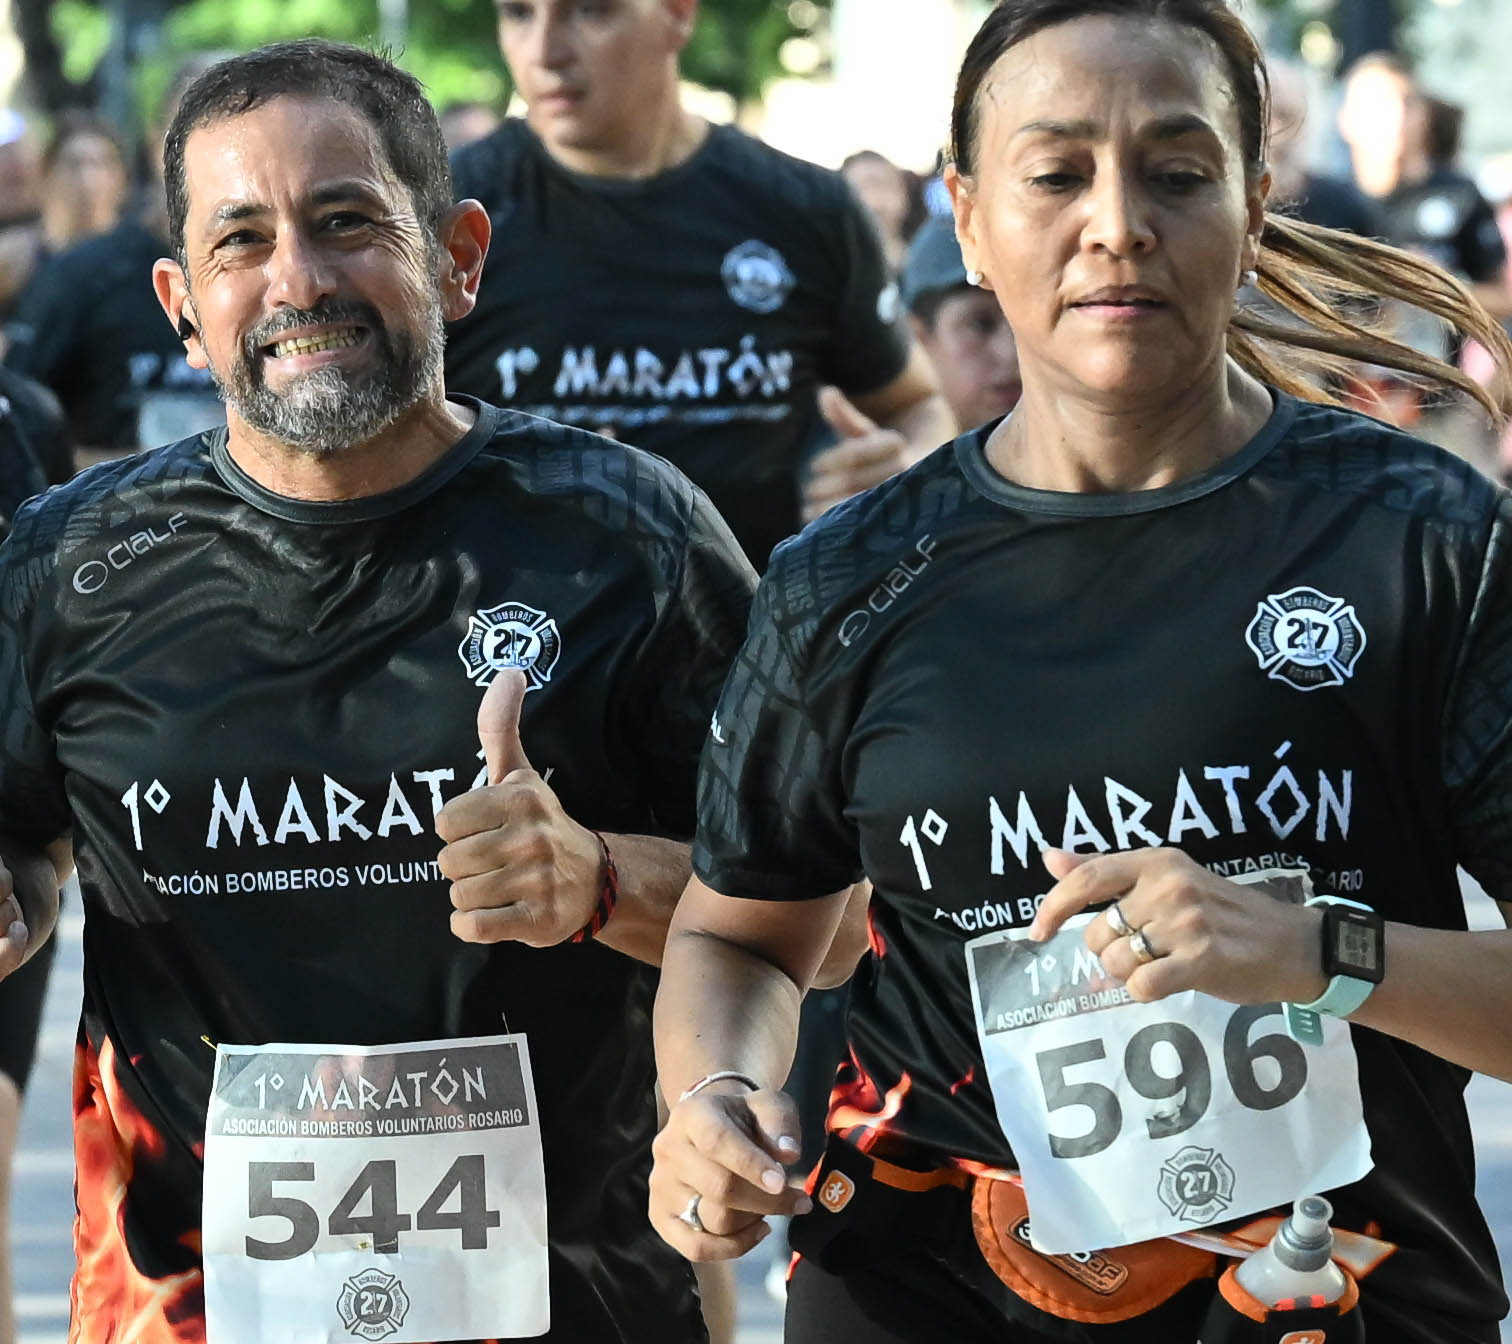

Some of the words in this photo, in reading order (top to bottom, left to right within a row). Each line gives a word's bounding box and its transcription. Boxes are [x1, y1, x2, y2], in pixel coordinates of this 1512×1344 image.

[553, 334, 794, 399] MARATÓN
[492, 627, 533, 661] 27
[1286, 617, 1330, 650] 27
[205, 749, 491, 849] MARAT
[988, 740, 1354, 876] MARATÓN
[226, 866, 350, 895] BOMBEROS
[1080, 986, 1132, 1013] BOMBE
[296, 1057, 487, 1112] MARATÓN
[1035, 1003, 1309, 1161] 596
[221, 1116, 297, 1136] ASOCIACIÓN
[300, 1118, 373, 1137] BOMBEROS
[376, 1113, 465, 1135] VOLUNTARIOS
[468, 1107, 523, 1128] ROSARIO
[1182, 1170, 1212, 1197] 27
[245, 1153, 501, 1261] 544
[359, 1290, 389, 1317] 27
